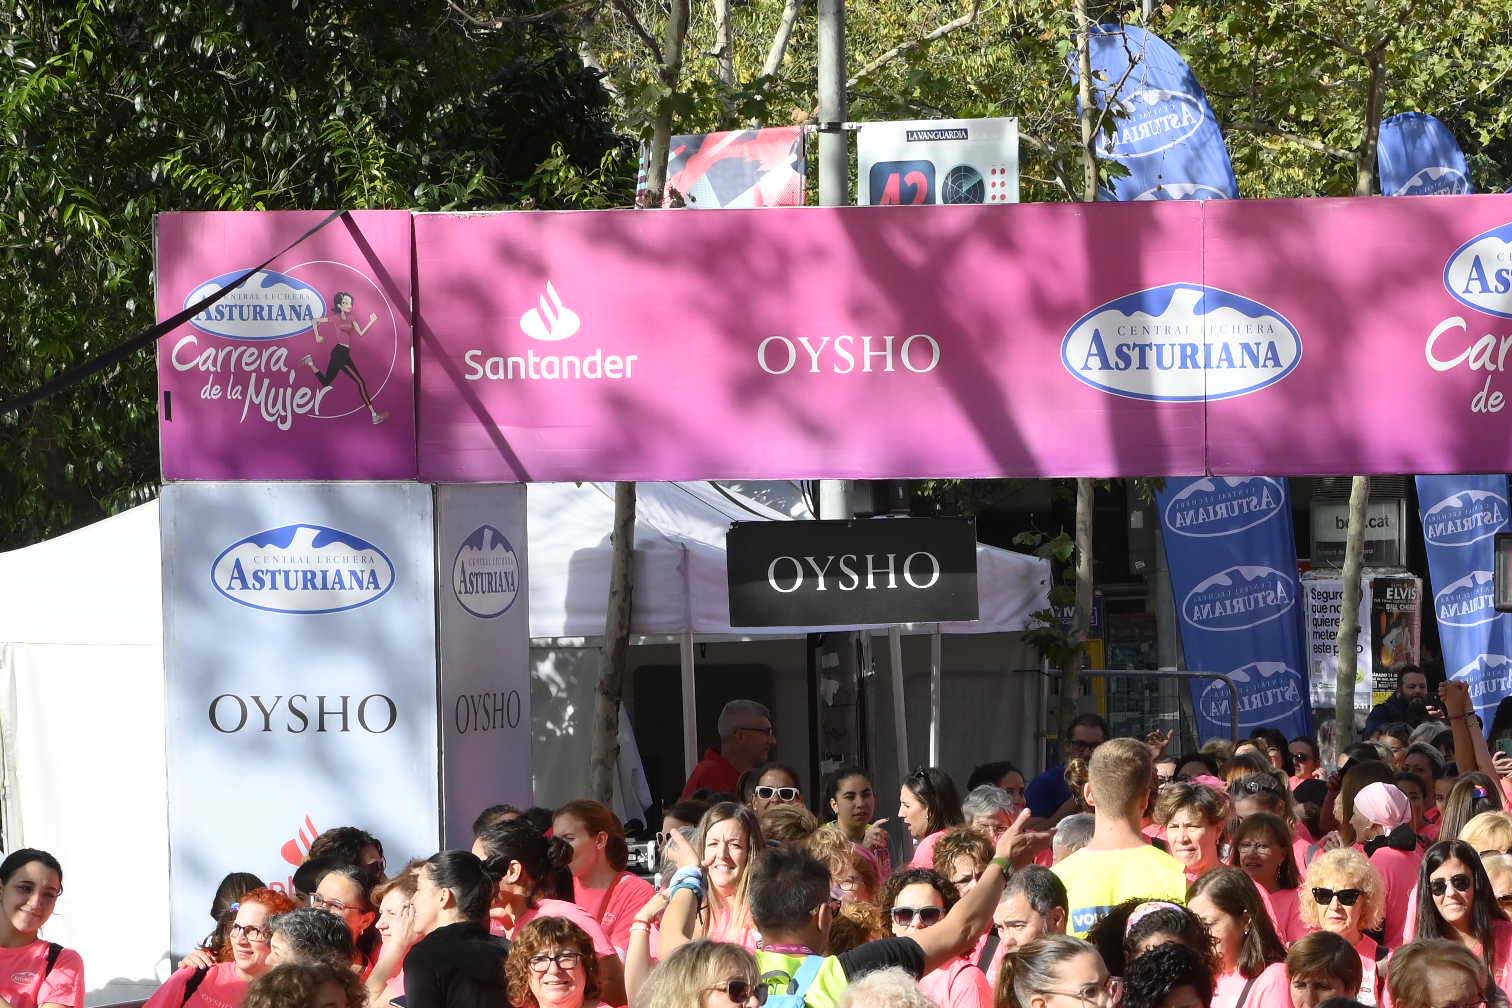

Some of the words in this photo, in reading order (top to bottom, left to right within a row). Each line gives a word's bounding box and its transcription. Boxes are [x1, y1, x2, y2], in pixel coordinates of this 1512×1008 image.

[195, 300, 315, 322] ASTURIANA
[172, 335, 289, 373] Carrera
[464, 349, 637, 381] Santander
[757, 334, 940, 374] OYSHO
[1081, 328, 1283, 371] ASTURIANA
[201, 375, 221, 400] de
[227, 374, 242, 400] la
[240, 369, 333, 431] Mujer
[1471, 374, 1506, 413] de
[226, 558, 381, 591] ASTURIANA
[253, 555, 310, 564] CENTRAL
[317, 555, 375, 564] LECHERA
[767, 551, 940, 592] OYSHO
[458, 561, 516, 595] ASTURIANA
[1386, 587, 1417, 601] ELVIS
[1312, 604, 1328, 616] que
[1312, 615, 1344, 629] quiere
[1313, 642, 1331, 654] este
[1333, 645, 1353, 657] po
[208, 694, 397, 733] OYSHO
[455, 690, 521, 734] OYSHO
